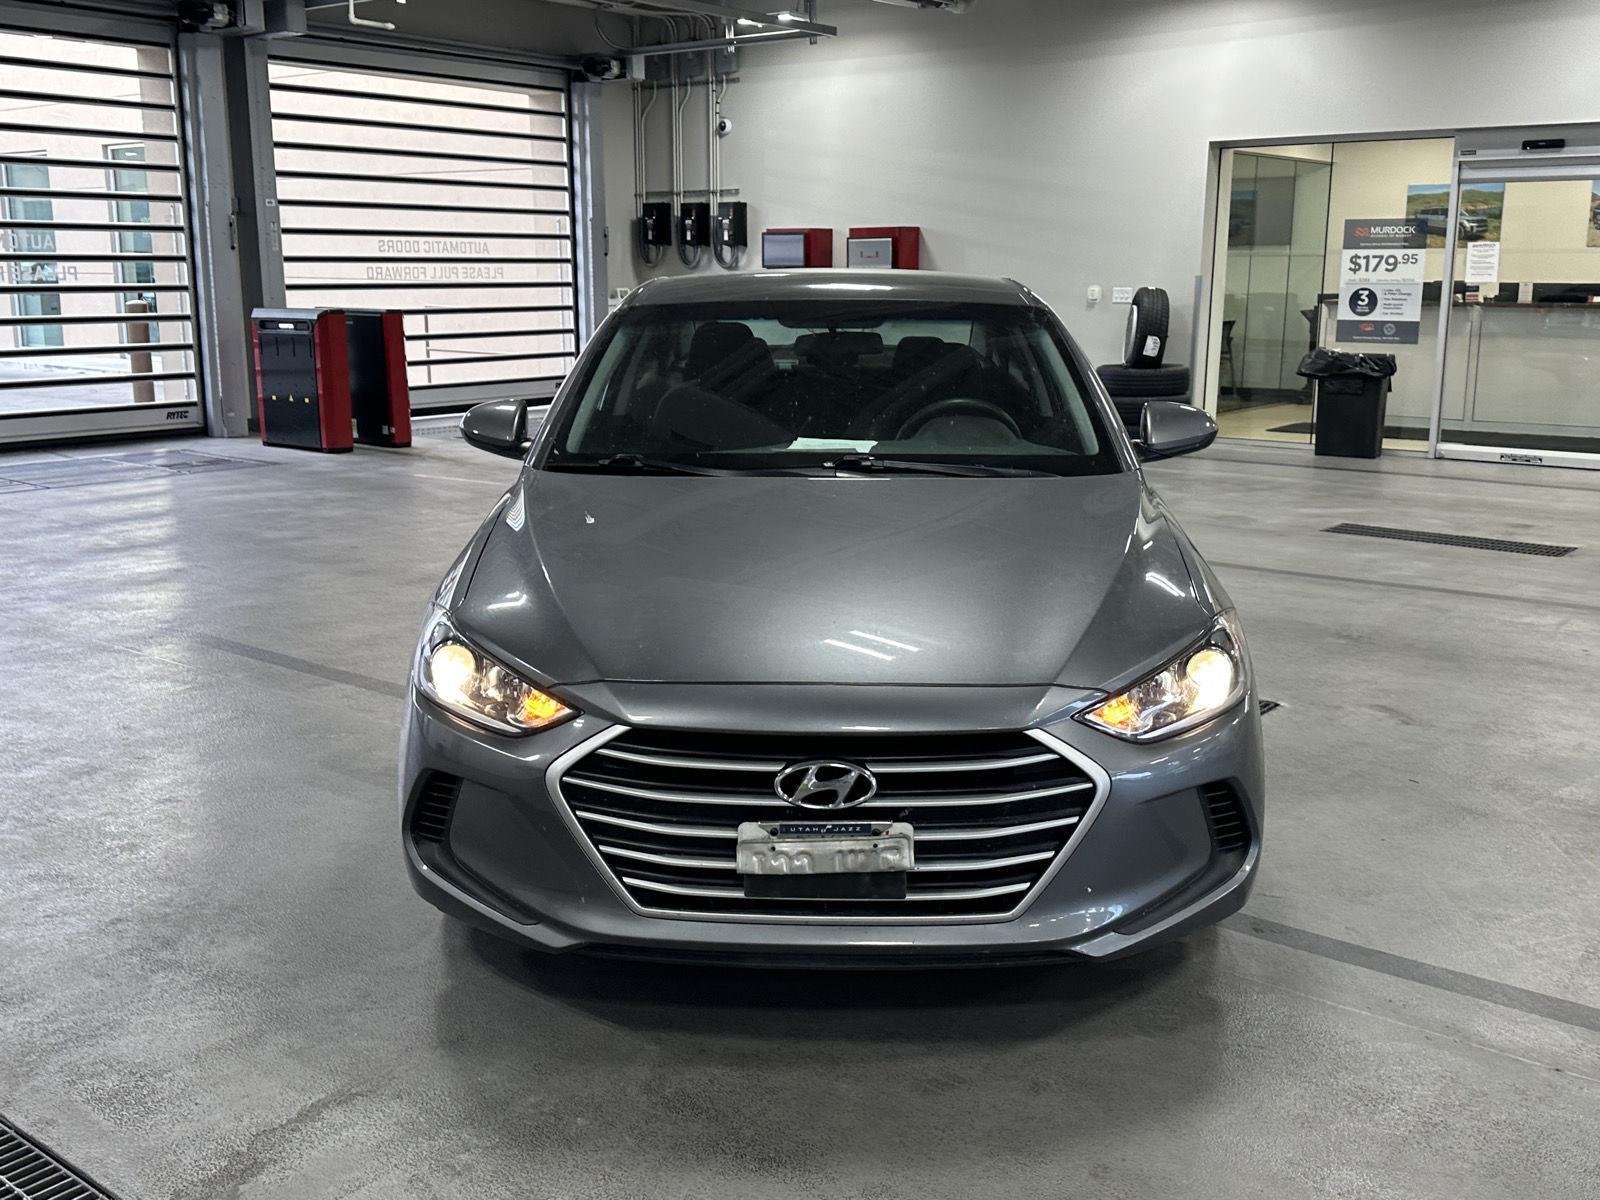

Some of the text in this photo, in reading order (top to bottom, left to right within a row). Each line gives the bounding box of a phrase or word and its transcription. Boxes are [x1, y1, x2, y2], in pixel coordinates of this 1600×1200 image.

[1370, 226, 1416, 234] MURDOCK
[1348, 254, 1419, 275] $179.95
[1357, 290, 1370, 306] 3
[166, 411, 189, 420] RYTEC
